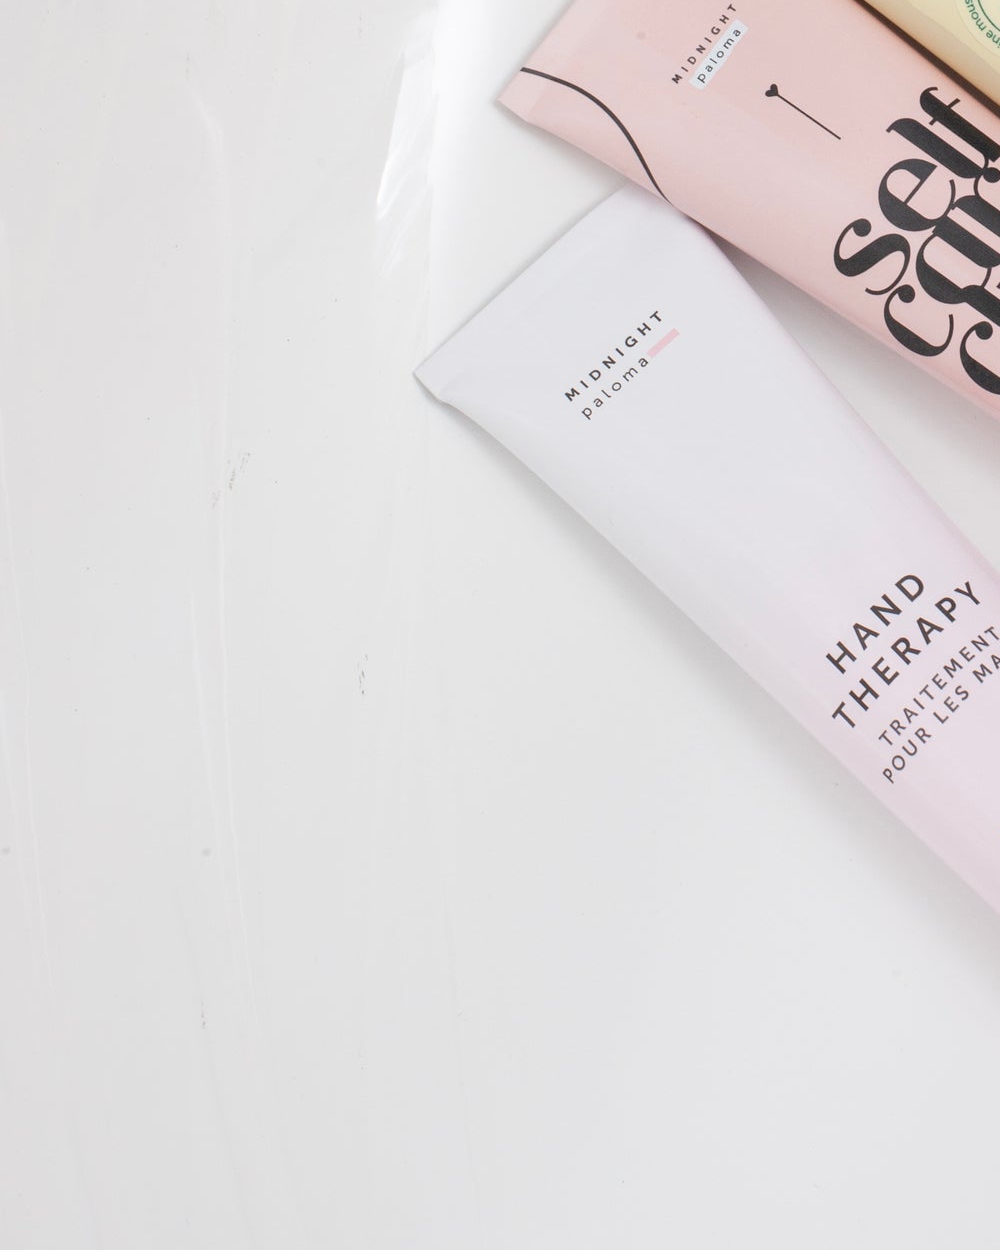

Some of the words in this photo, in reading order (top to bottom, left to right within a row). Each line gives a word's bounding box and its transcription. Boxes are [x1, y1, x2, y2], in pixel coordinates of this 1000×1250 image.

[672, 4, 736, 84] MIDNIGHT
[697, 30, 741, 84] paloma
[565, 311, 662, 402] MIDNIGHT
[582, 357, 648, 420] paloma
[826, 574, 924, 674] HAND
[831, 581, 980, 728] THERAPY
[878, 626, 1000, 746] TRAITEMENT
[882, 727, 932, 784] POUR
[933, 685, 969, 724] LES
